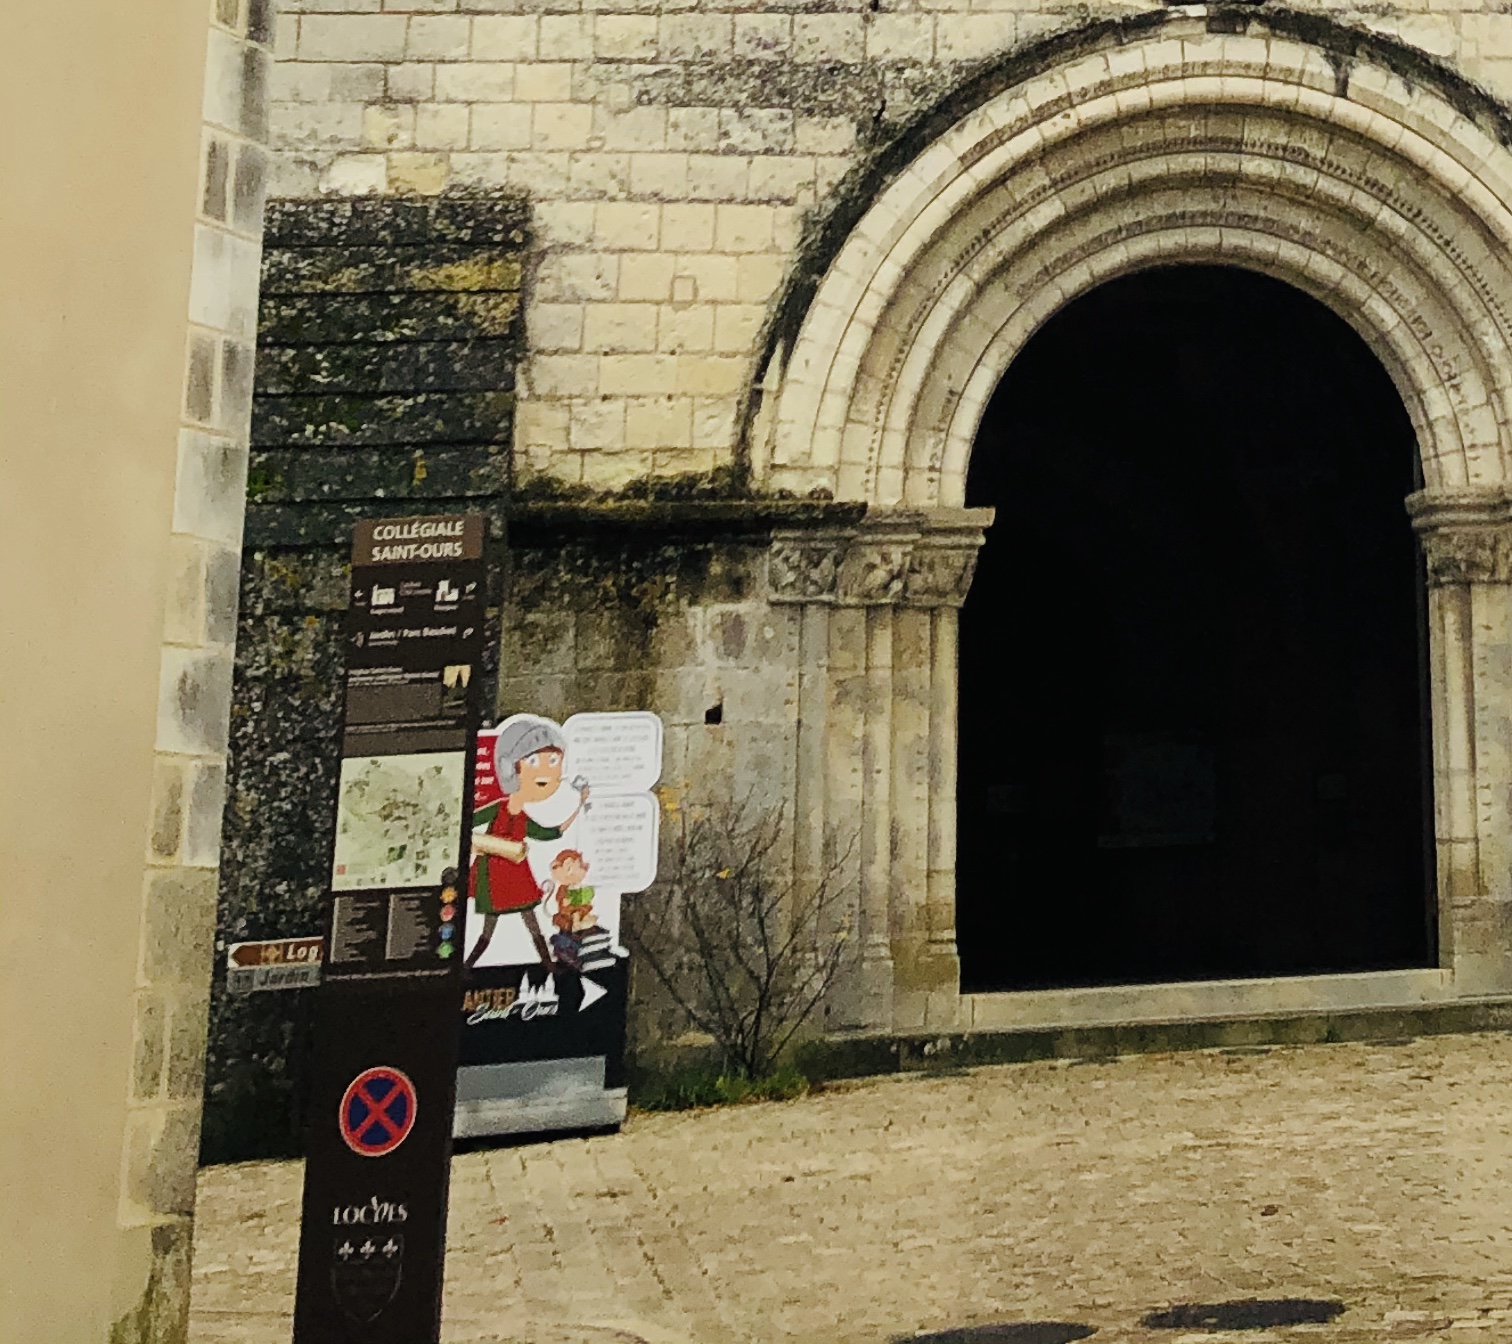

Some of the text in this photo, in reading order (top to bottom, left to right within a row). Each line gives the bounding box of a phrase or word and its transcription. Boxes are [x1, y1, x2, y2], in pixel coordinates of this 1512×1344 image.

[372, 520, 465, 540] COLLÉGIALE
[371, 541, 464, 561] SAINT-OURS
[286, 943, 322, 962] Log
